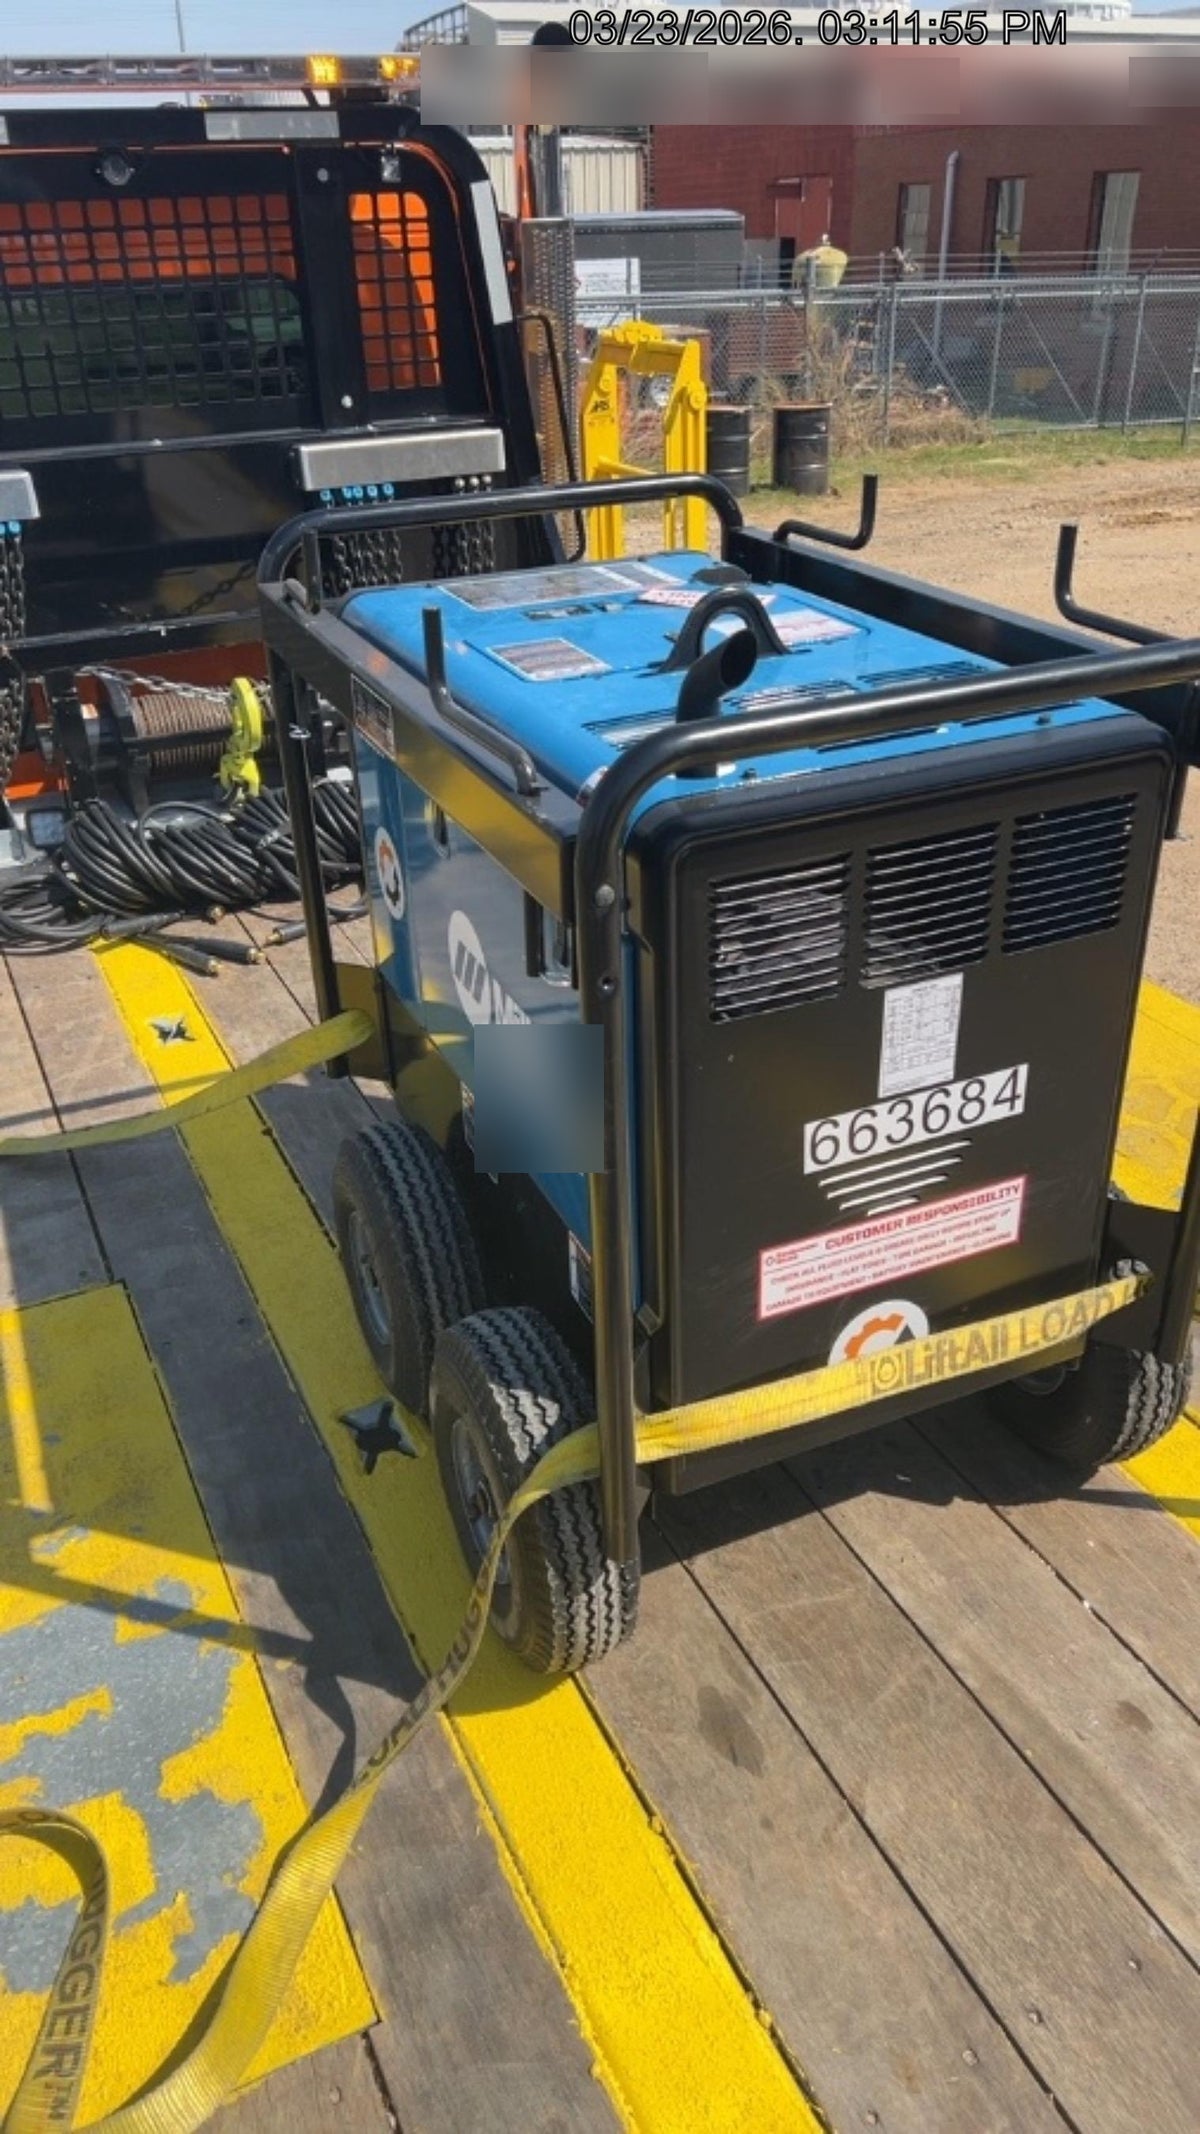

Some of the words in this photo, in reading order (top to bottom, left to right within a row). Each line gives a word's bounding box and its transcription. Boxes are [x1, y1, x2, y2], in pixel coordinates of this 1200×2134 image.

[810, 1068, 1021, 1165] 663684
[825, 1218, 903, 1250] CUSTOMER
[905, 1184, 1020, 1226] RESPONSIBILITY
